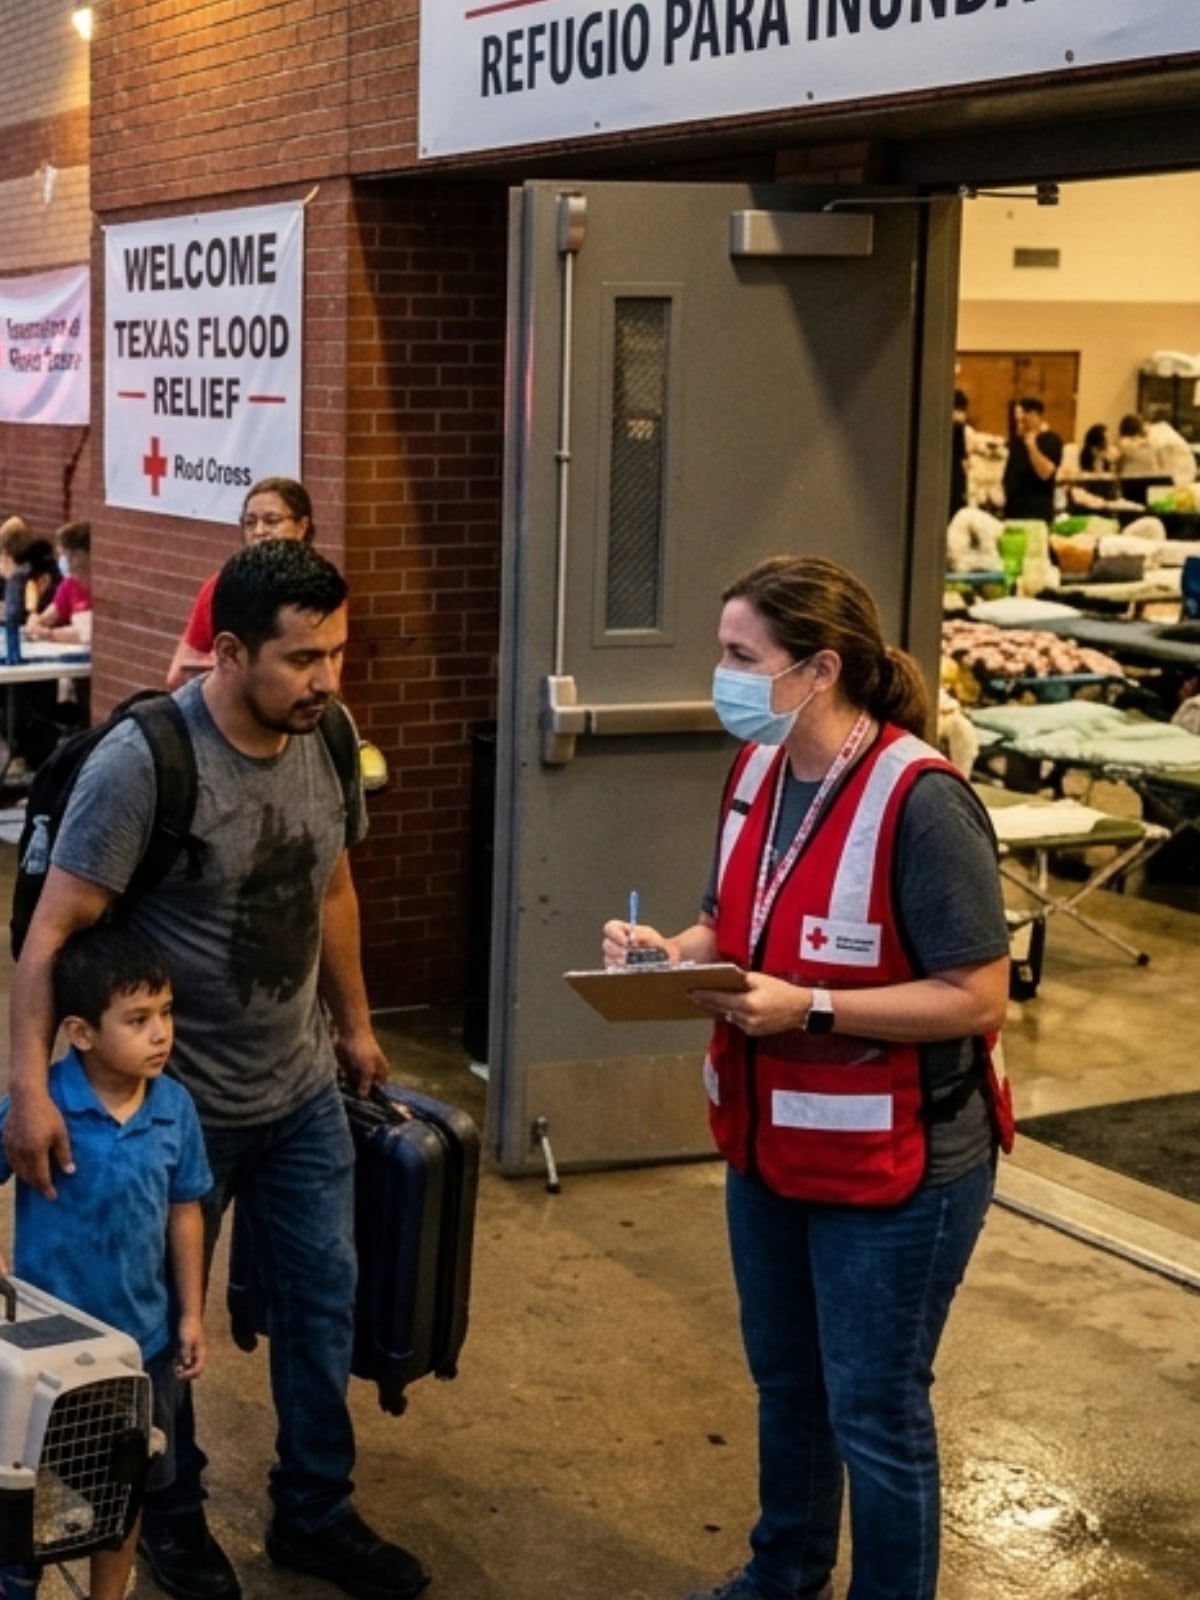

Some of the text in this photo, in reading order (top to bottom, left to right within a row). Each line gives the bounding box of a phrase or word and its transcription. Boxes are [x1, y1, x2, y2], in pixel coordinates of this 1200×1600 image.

[481, 3, 649, 97] REFUGIO
[664, 0, 789, 66] PARA
[124, 232, 276, 292] WELCOME
[114, 319, 189, 359] TEXAS
[198, 315, 289, 359] FLOOD
[153, 377, 240, 419] RELIEF
